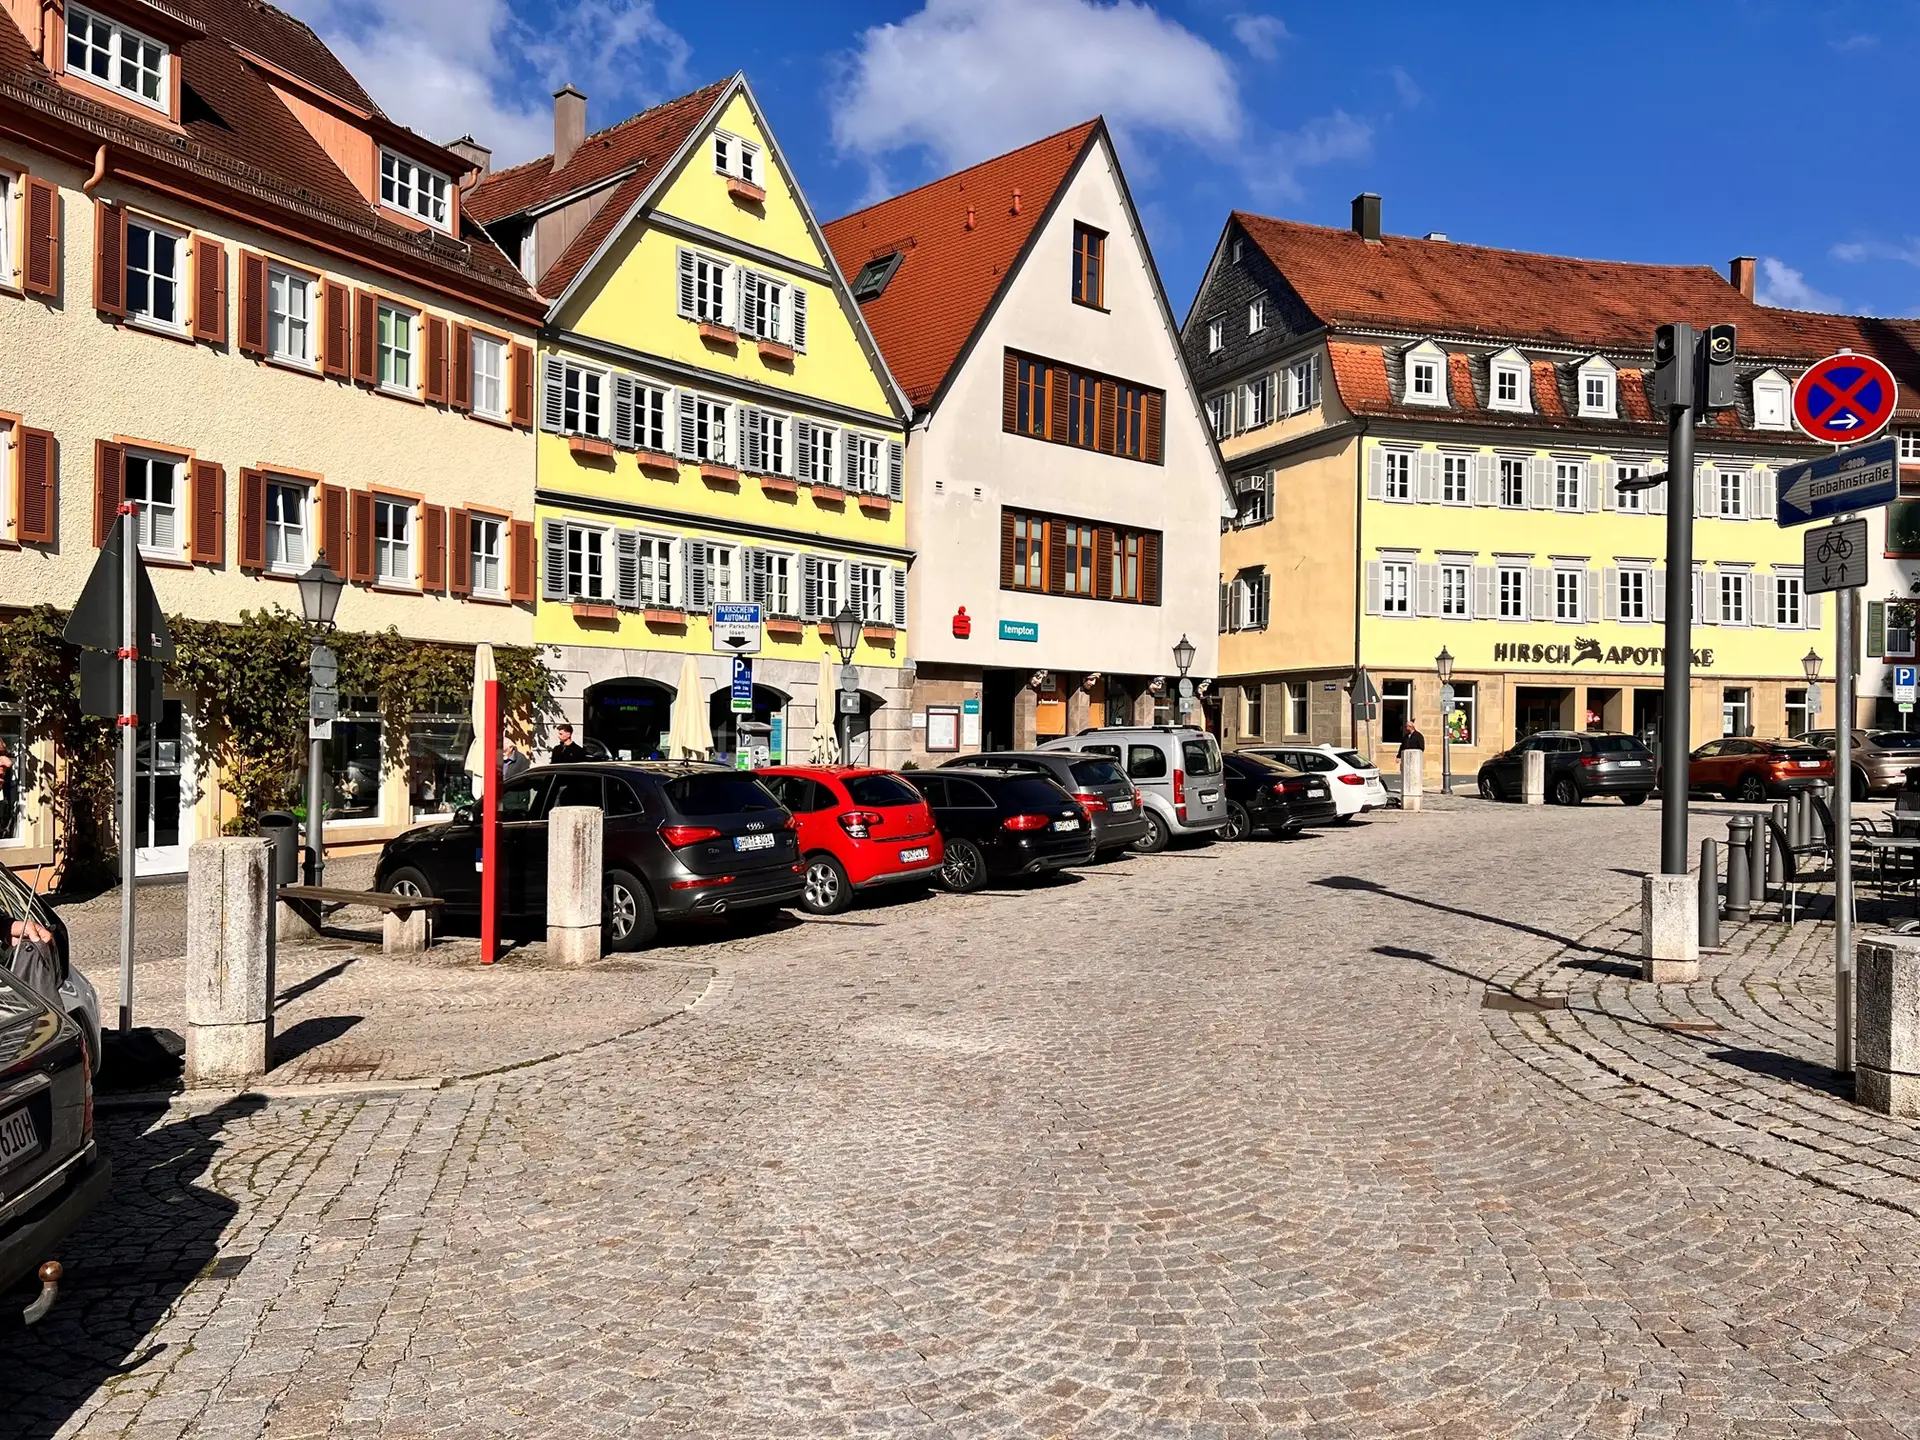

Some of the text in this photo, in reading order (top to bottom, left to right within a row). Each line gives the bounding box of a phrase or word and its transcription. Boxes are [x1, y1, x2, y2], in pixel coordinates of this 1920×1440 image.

[1809, 467, 1889, 497] Einbahnstraße
[717, 605, 758, 614] PARKSCHEIN-
[723, 613, 752, 622] AUTOMAT
[1004, 624, 1035, 636] tempton
[1494, 643, 1714, 667] HIRSCH APOTKE
[734, 659, 745, 678] P
[1899, 668, 1911, 685] P
